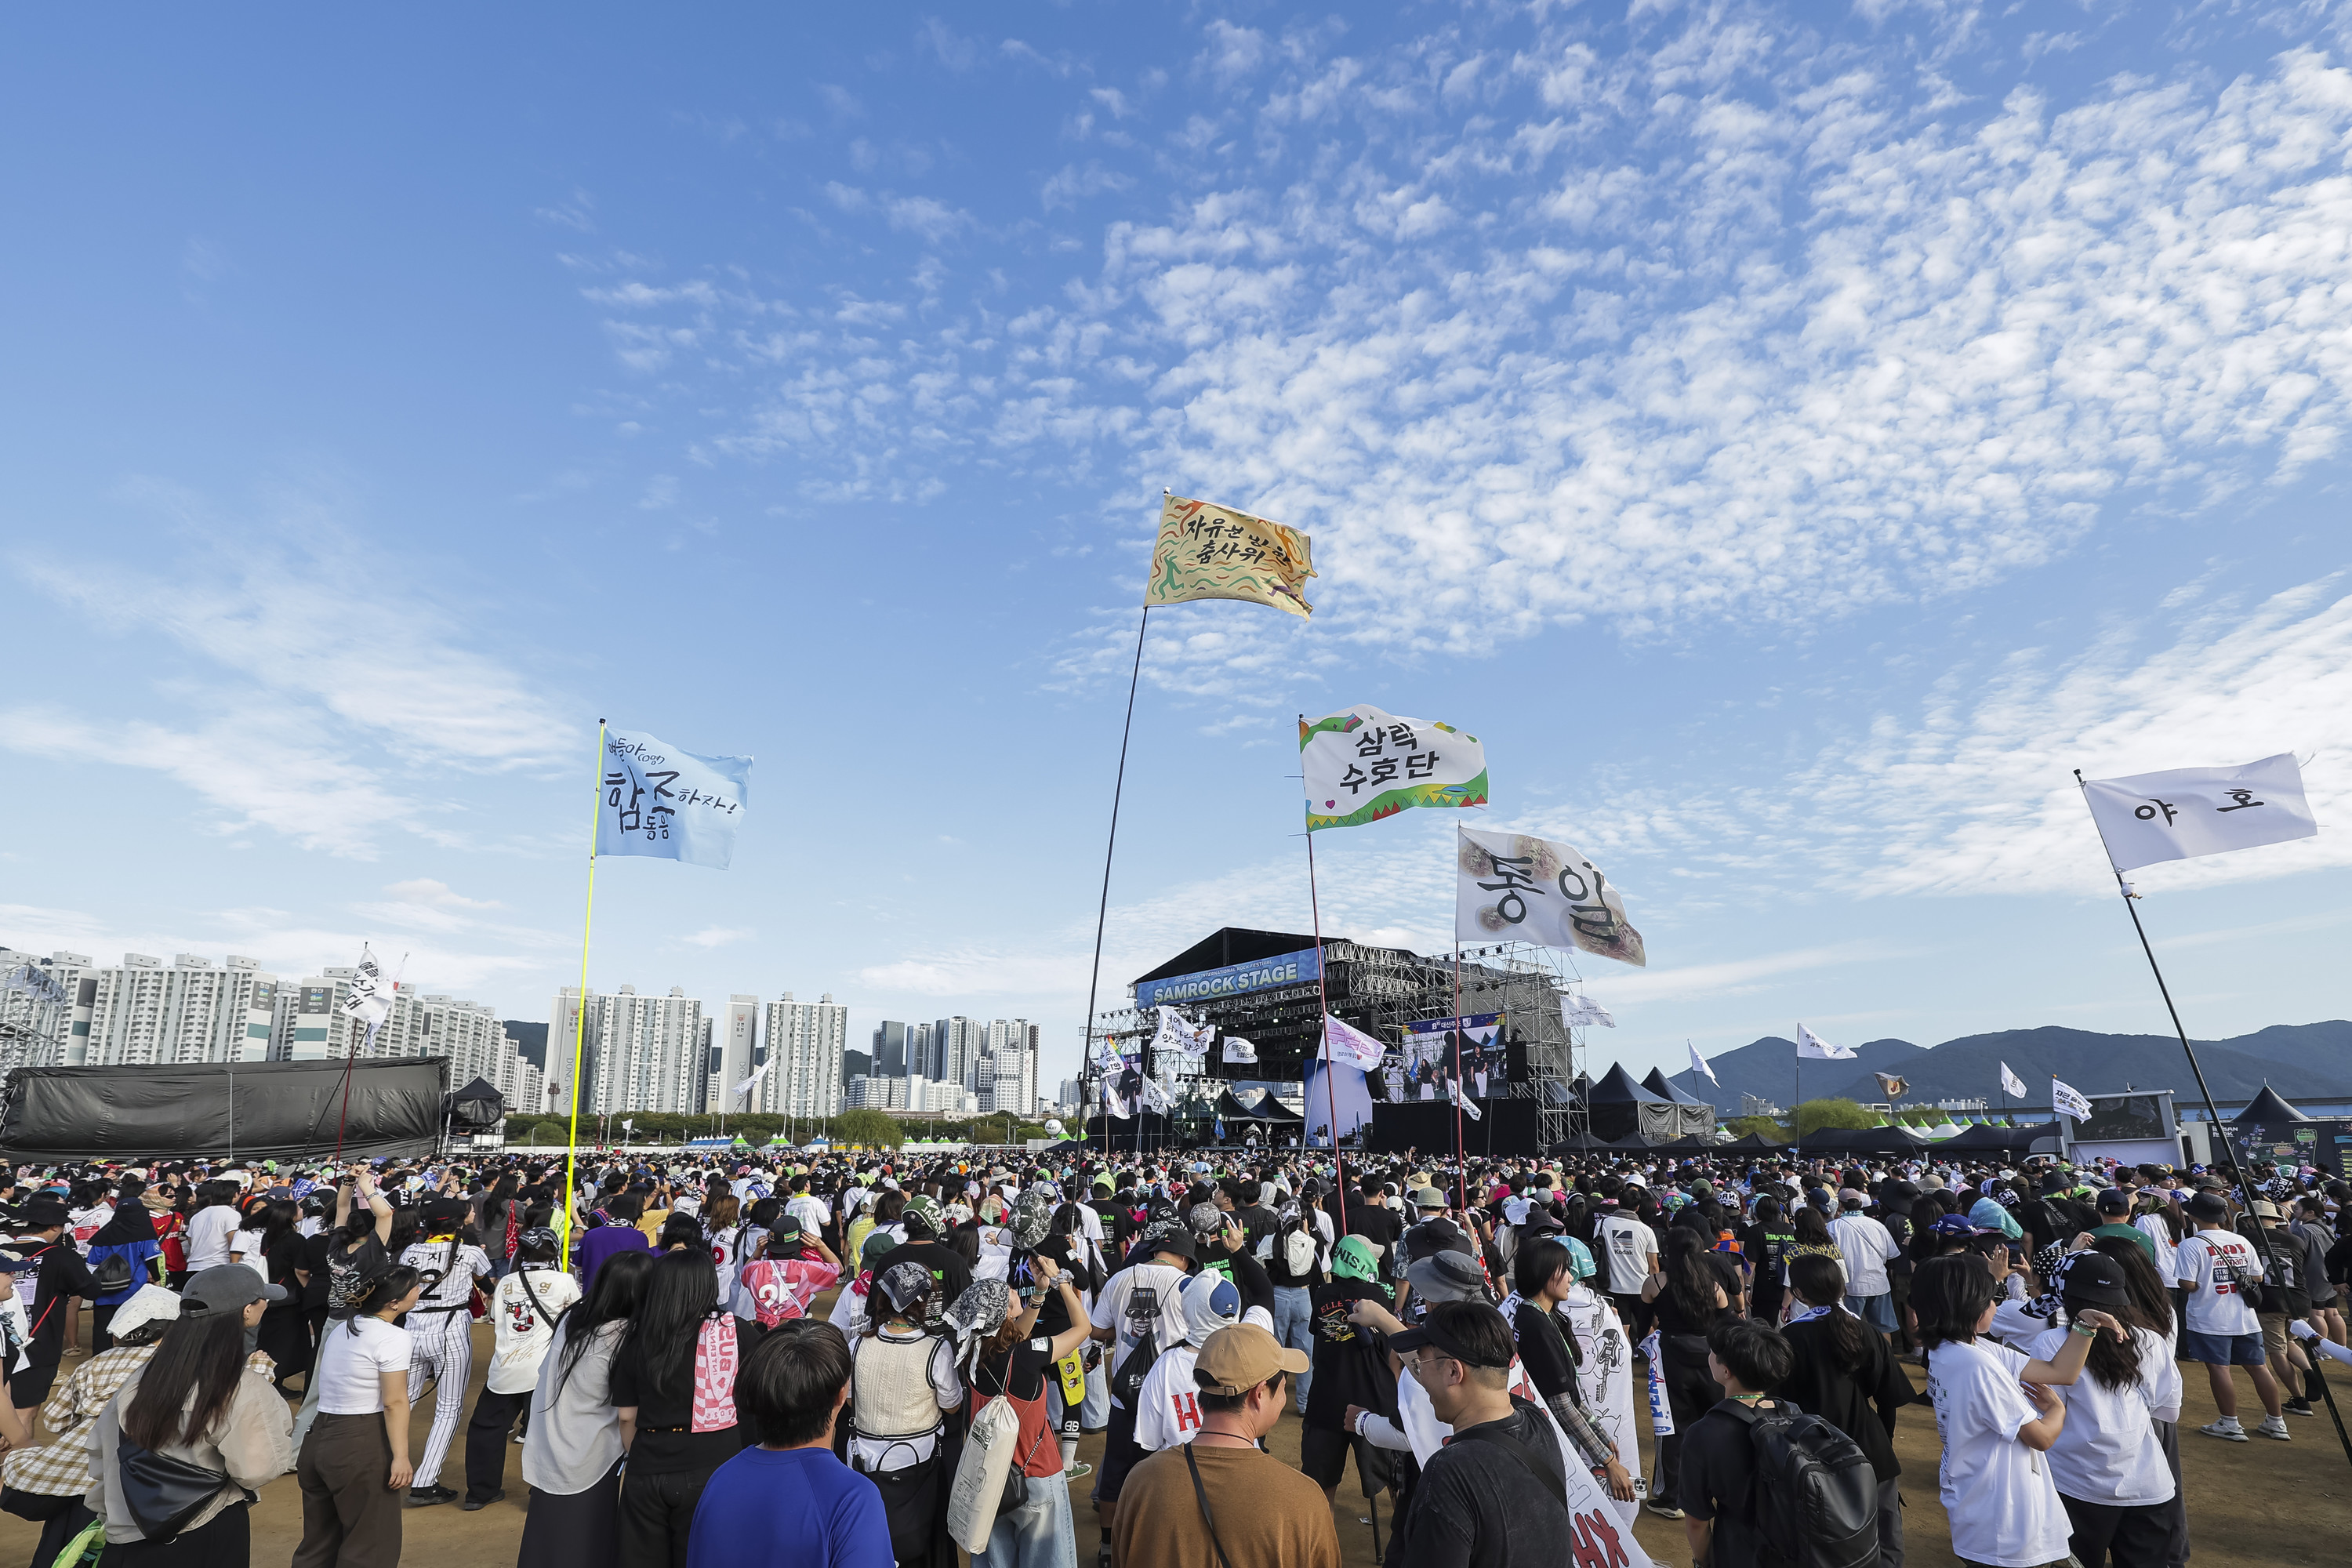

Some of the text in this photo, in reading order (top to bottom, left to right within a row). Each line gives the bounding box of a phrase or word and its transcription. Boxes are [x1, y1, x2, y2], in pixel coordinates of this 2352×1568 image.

[1196, 539, 1265, 564] 춤사위
[1355, 723, 1418, 758] 삼락
[1340, 750, 1440, 795] 수호단
[678, 788, 738, 815] 하자!
[2134, 789, 2265, 828] 야호
[1153, 963, 1298, 1004] SAMROCK STAGE
[1201, 967, 1236, 978] INTERNATIONAL
[1250, 960, 1273, 969] FESTIVAL
[563, 1058, 574, 1106] DONG WON
[1320, 1300, 1343, 1313] ELLE
[1171, 1391, 1204, 1432] H
